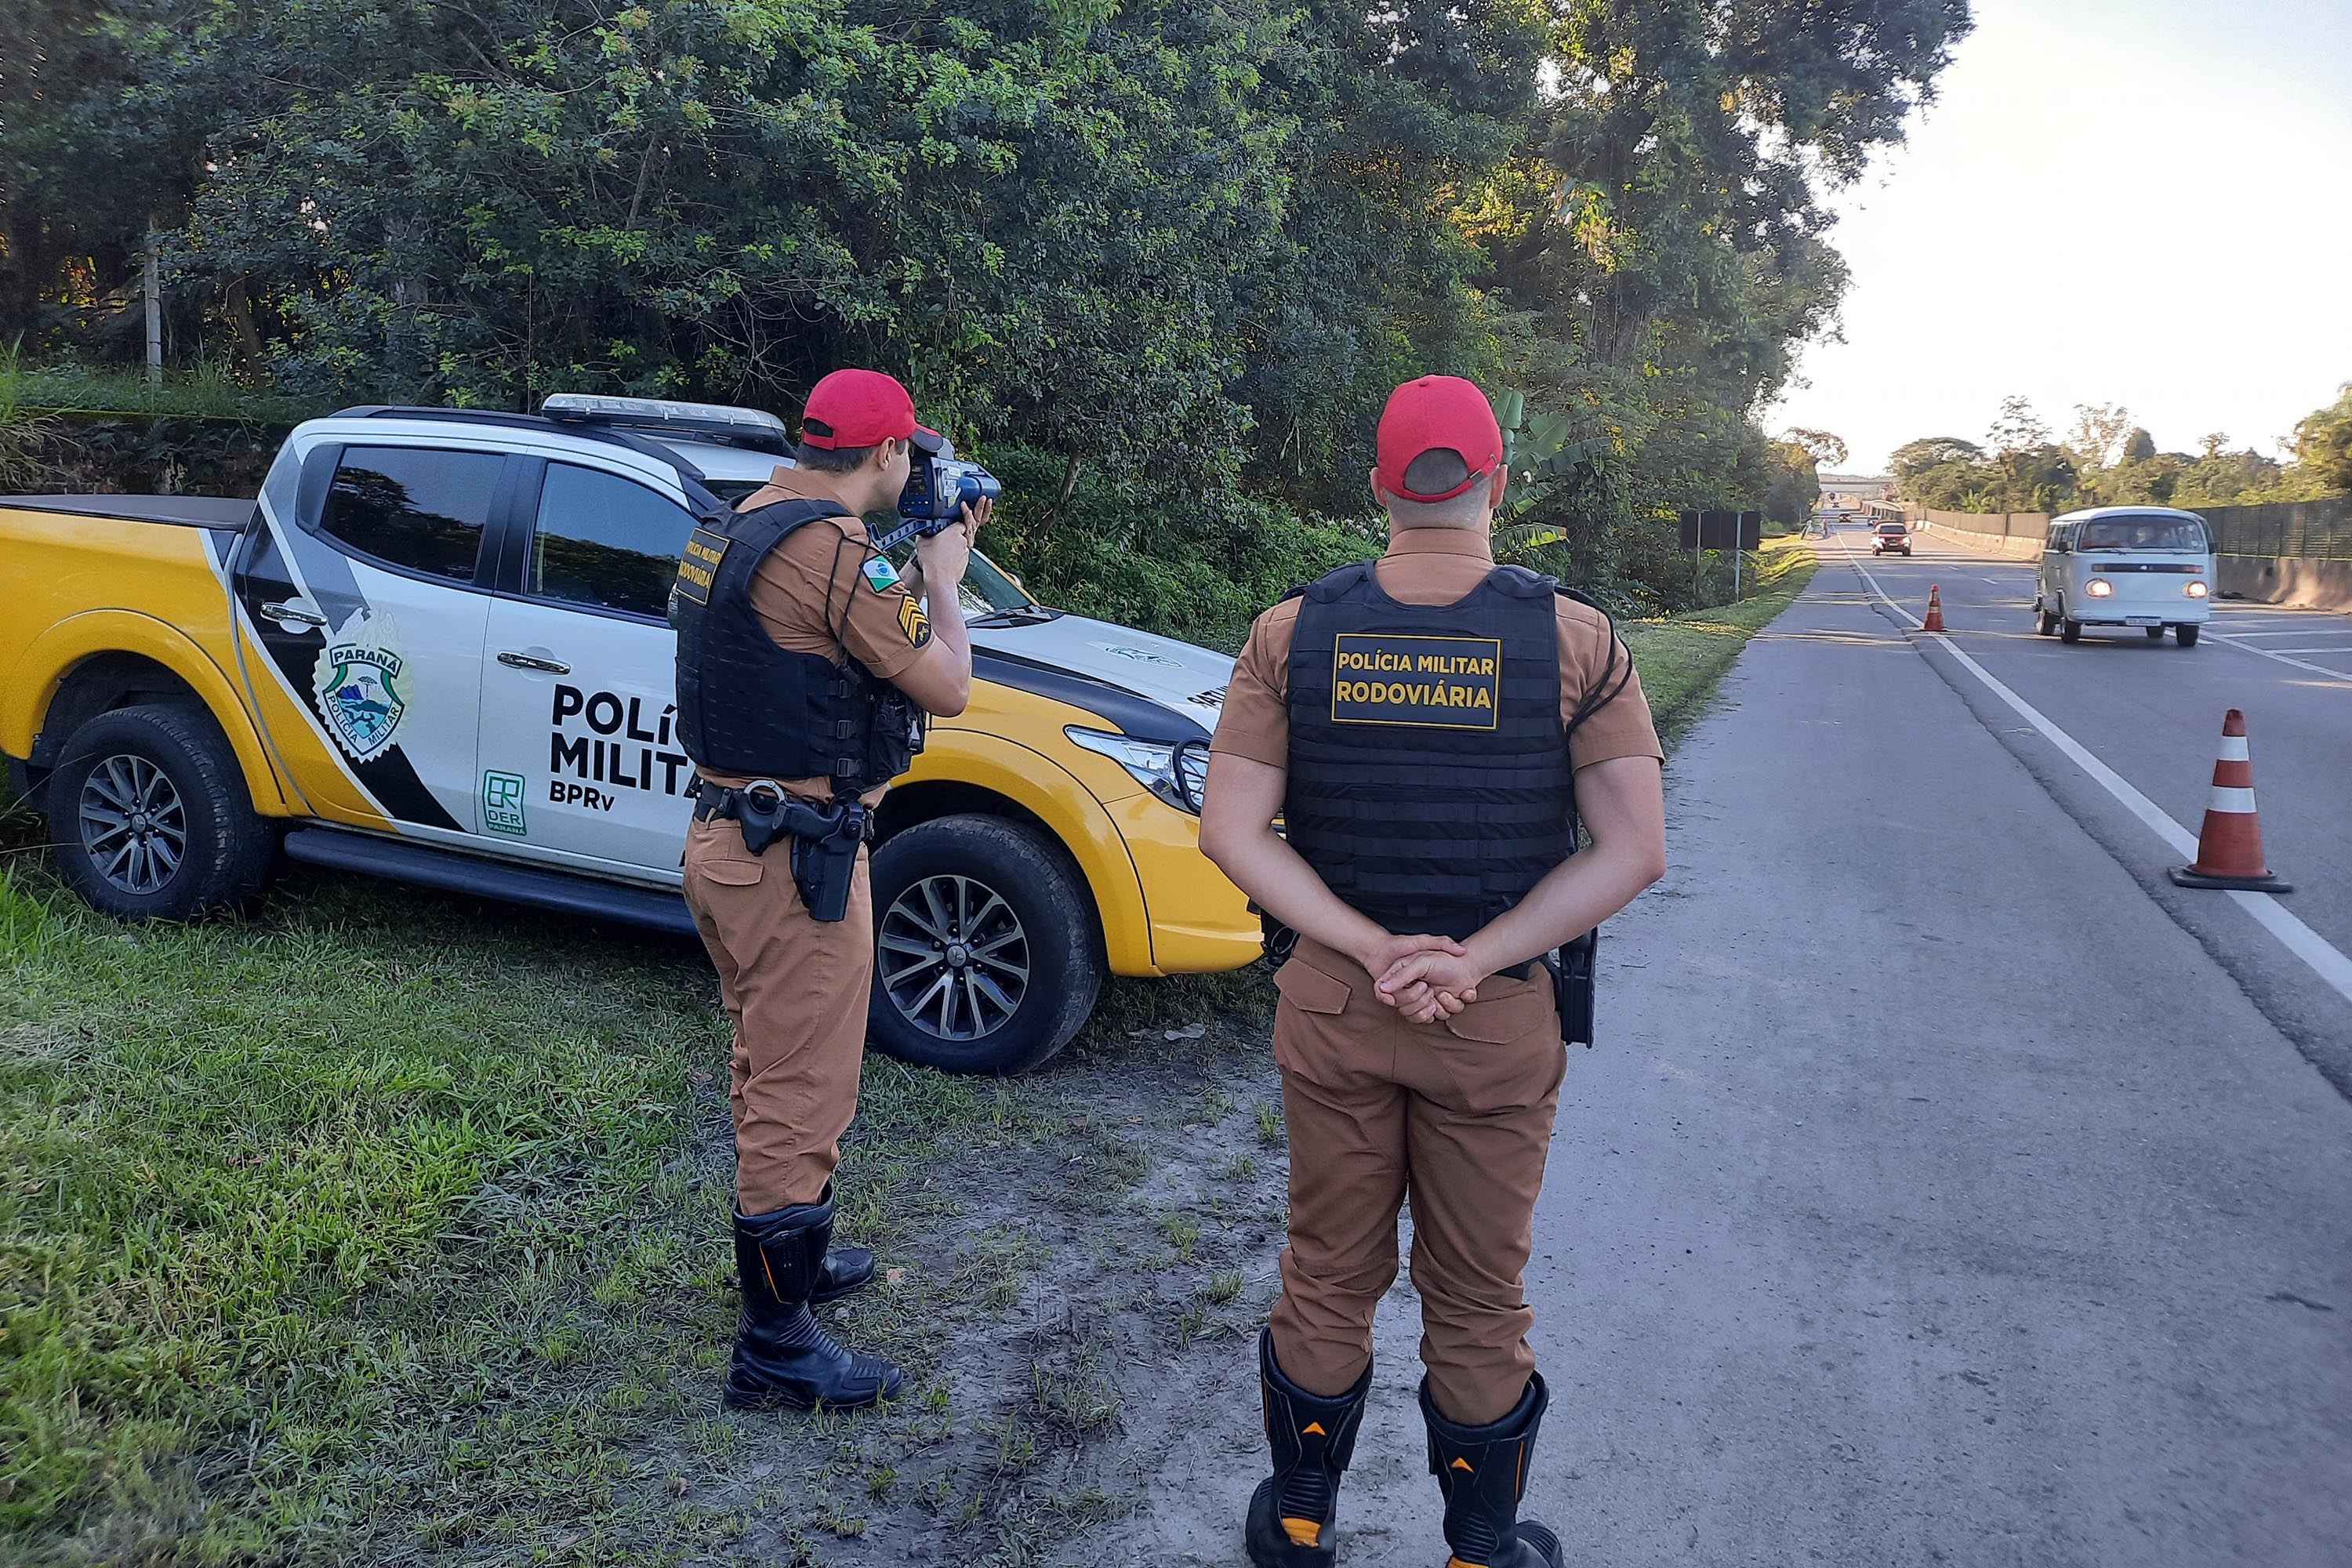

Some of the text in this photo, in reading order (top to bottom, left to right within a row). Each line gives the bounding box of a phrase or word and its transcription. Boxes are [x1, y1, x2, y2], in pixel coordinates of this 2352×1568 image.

[333, 649, 398, 673] PARANÁ
[1338, 648, 1494, 676] POLÍCIA MILITAR
[1337, 679, 1492, 709] RODOVIÁRIA
[368, 706, 399, 746] MILITAR
[552, 684, 677, 746] POLÍ
[550, 731, 696, 799] MILIT
[488, 809, 521, 826] DER
